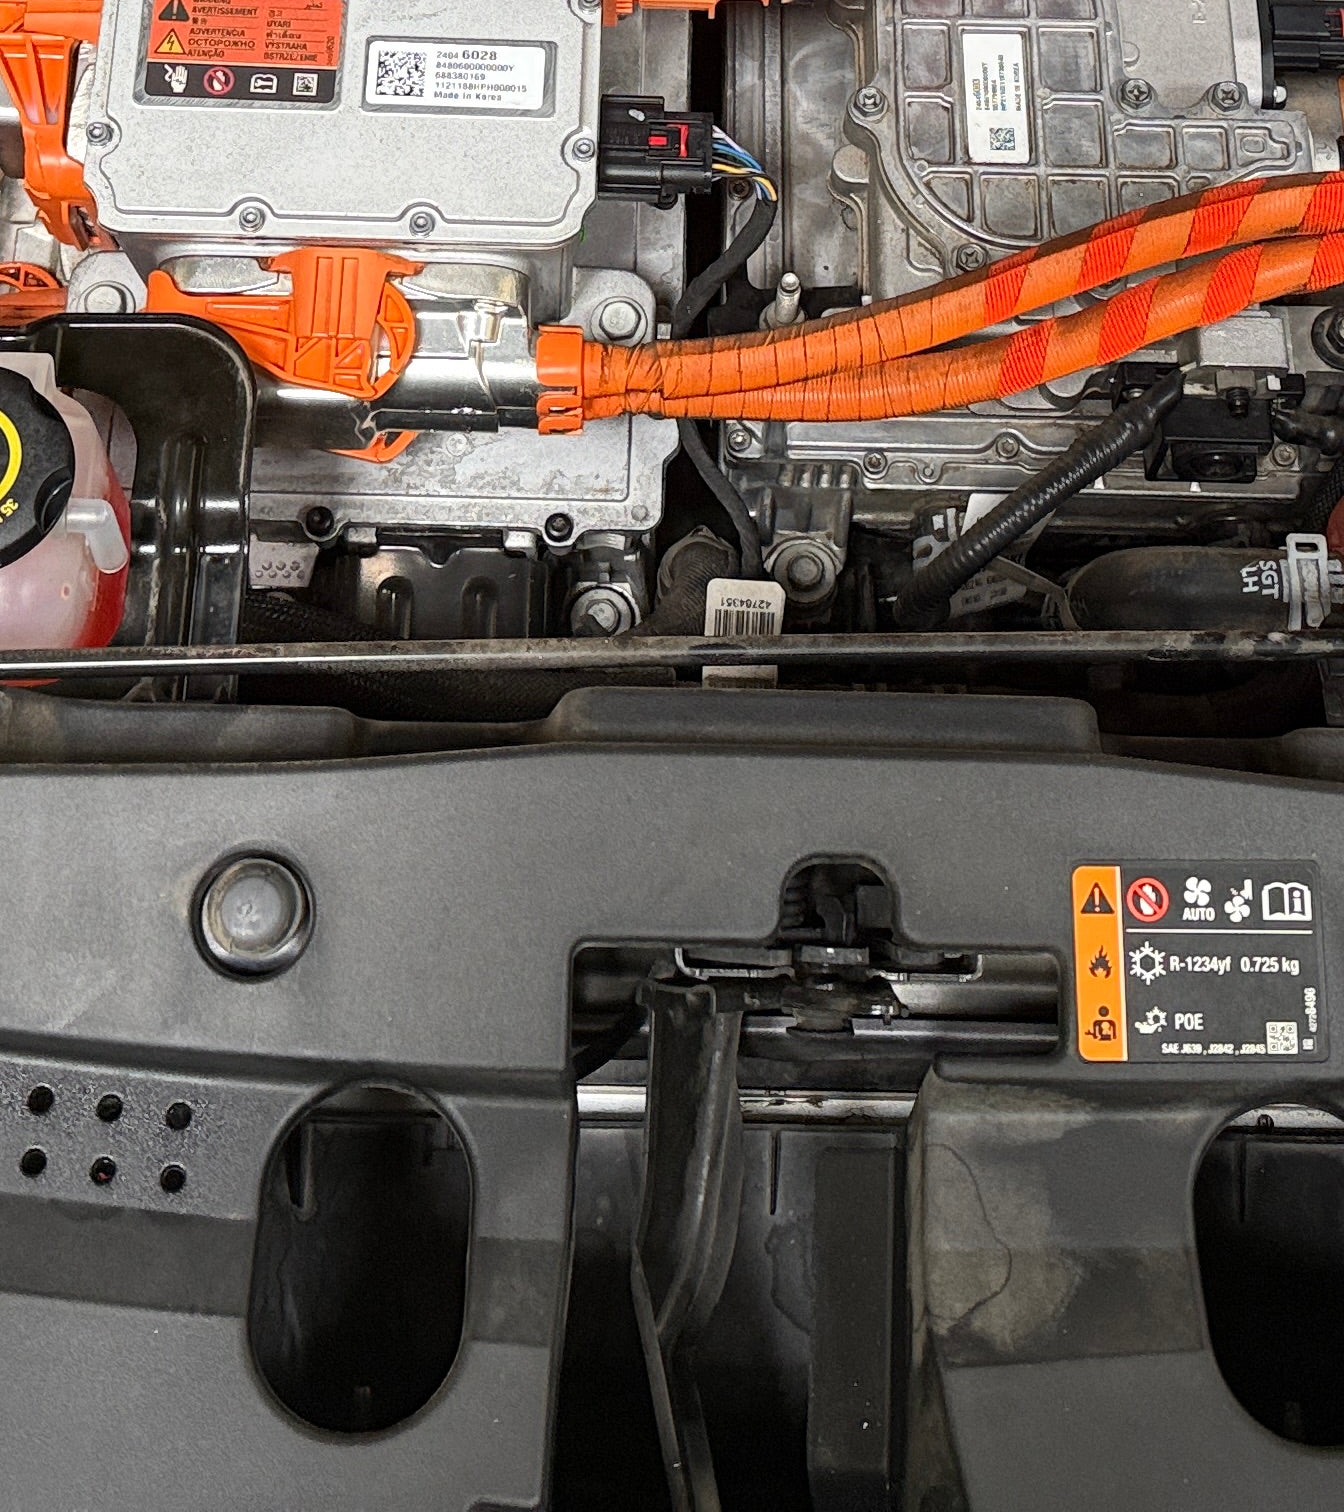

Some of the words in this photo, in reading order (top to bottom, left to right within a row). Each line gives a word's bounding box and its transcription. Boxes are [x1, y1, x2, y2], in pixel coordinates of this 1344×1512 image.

[462, 49, 498, 61] 6028
[433, 91, 460, 100] Made
[475, 92, 502, 102] Korea
[0, 498, 19, 518] 35
[1240, 564, 1260, 593] LH
[1258, 560, 1280, 600] SGT
[1182, 907, 1216, 922] AUTO
[1169, 955, 1232, 976] R-1234yf
[1240, 955, 1279, 974] 0.725
[1281, 956, 1301, 976] kg
[1174, 1013, 1204, 1031] POE
[1161, 1043, 1180, 1055] SAE
